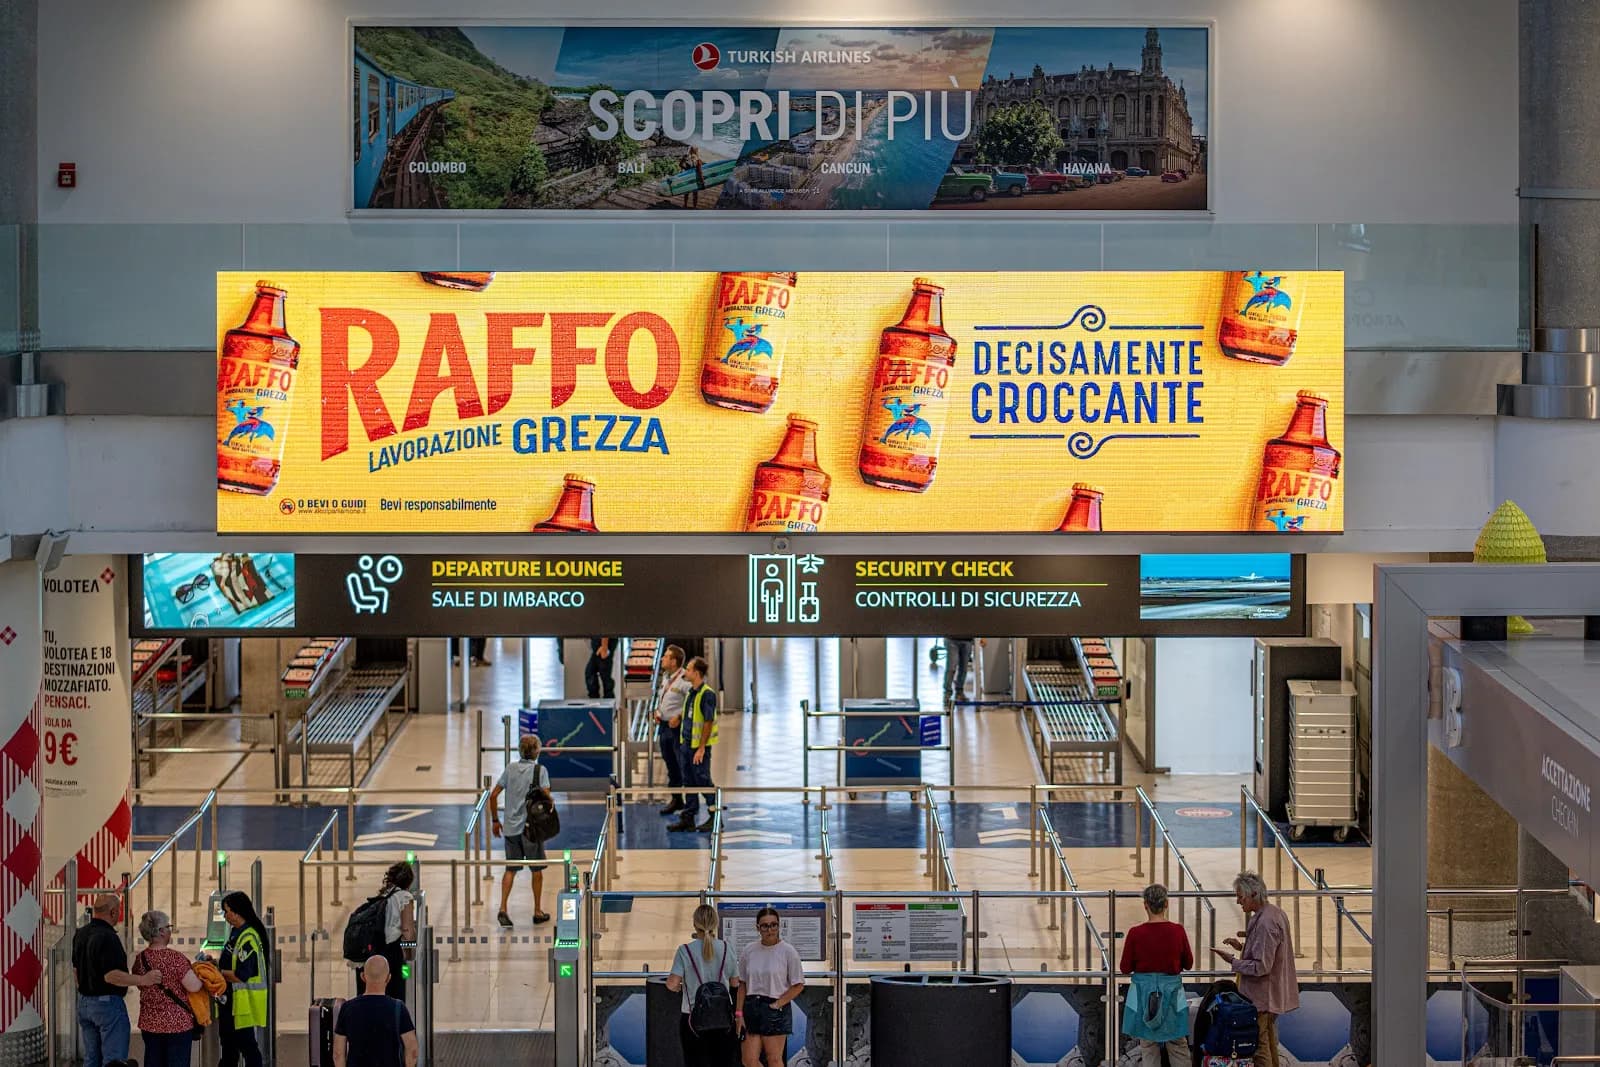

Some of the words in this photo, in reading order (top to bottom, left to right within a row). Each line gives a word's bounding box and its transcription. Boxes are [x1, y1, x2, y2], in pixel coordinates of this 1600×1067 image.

[728, 50, 796, 63] TURKISH
[801, 50, 872, 64] AIRLINES
[587, 89, 791, 141] SCOPRI
[815, 90, 862, 141] DI
[887, 74, 972, 141] PIÙ
[408, 161, 467, 174] COLOMBO
[618, 161, 646, 174] BALI
[820, 162, 871, 175] CANCUN
[1063, 162, 1112, 175] HAVANA
[718, 275, 790, 309] RAFFO
[755, 306, 786, 319] GREZZA
[974, 340, 1204, 375] DECISAMENTE
[217, 357, 292, 393] RAFFO
[873, 356, 949, 390] RAFFO
[319, 307, 681, 463] RAFFO
[257, 388, 288, 401] GREZZA
[970, 381, 1204, 424] CROCCANTE
[368, 423, 503, 474] LAVORAZIONE
[513, 414, 670, 455] GREZZA
[1256, 469, 1332, 502] RAFFO
[298, 499, 304, 508] O
[307, 499, 329, 508] BEVI
[332, 499, 338, 508] O
[341, 499, 366, 508] GUIDI
[380, 498, 401, 511] Bevi
[404, 498, 497, 512] responsabilmente
[747, 491, 823, 525] RAFFO
[431, 560, 543, 577] DEPARTURE
[545, 560, 623, 577] LOUNGE
[855, 560, 947, 577] SECURITY
[951, 560, 1015, 577] CHECK
[43, 578, 100, 593] VOLOTEA
[431, 591, 476, 608] SALE
[480, 591, 498, 608] DI
[503, 591, 585, 608] IMBARCO
[855, 591, 956, 608] CONTROLLI
[961, 591, 979, 608] DI
[984, 591, 1082, 608] SICUREZZA
[44, 630, 57, 646] TU,
[44, 646, 89, 661] VOLOTEA
[91, 647, 98, 661] E
[101, 646, 112, 660] 18
[44, 661, 115, 677] DESTINAZIONI
[44, 678, 111, 693] MOZZAFIATO.
[44, 695, 91, 710] PENSACI.
[44, 716, 60, 728] VOLA
[62, 718, 72, 729] DA
[44, 731, 78, 766] 9€
[1541, 754, 1591, 813] ACCETTAZIONE
[1551, 795, 1580, 838] CHECK-IN
